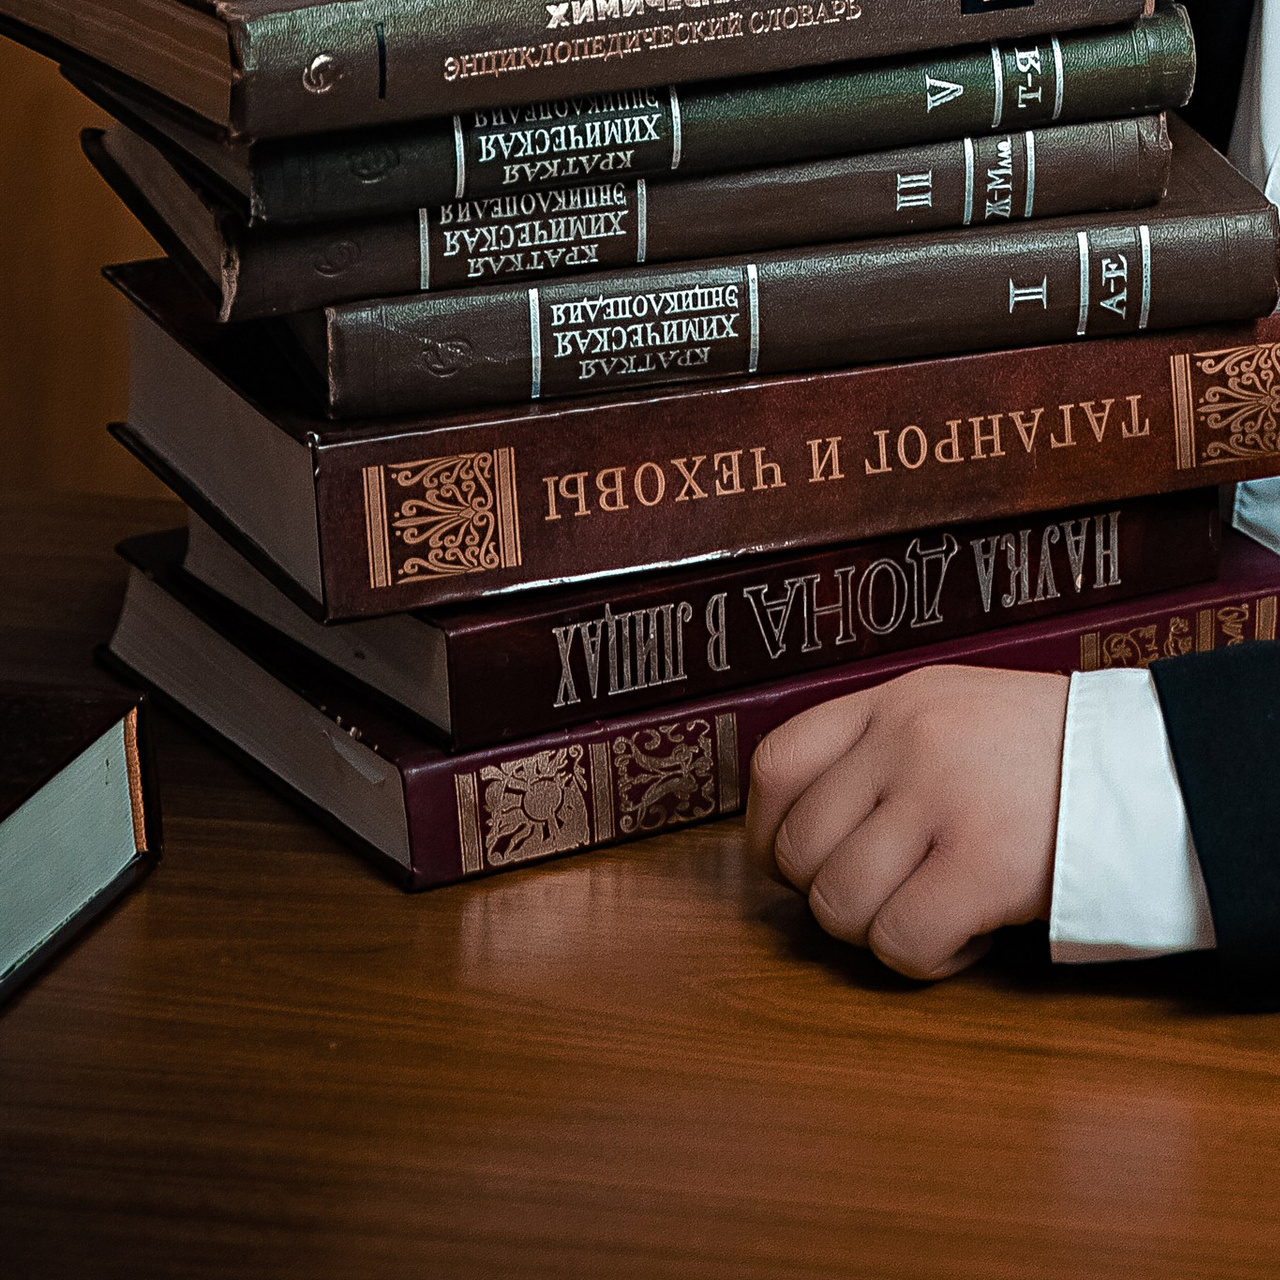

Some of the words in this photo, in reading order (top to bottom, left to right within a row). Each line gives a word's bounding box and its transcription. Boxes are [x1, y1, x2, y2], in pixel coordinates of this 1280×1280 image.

[444, 11, 744, 81] ЭНЦИКЛОПЕДИЧЕСКИЙ
[925, 73, 964, 114] V
[1015, 45, 1043, 109] Т-Я
[478, 113, 662, 163] ХИМИЧЕСКАЯ
[502, 149, 635, 185] КРАТКАЯ
[896, 169, 933, 212] II
[443, 209, 629, 257] ХИМИЧЕСКАЯ
[467, 243, 599, 278] КРАТКАЯ
[550, 284, 739, 327] ЭНЦИКЛОПЕДИЯ
[1009, 274, 1047, 314] I
[1099, 253, 1129, 321] А-Е
[553, 312, 740, 359] ХИМИЧЕСКАЯ
[578, 346, 711, 380] КРАТКАЯ
[865, 394, 1151, 475] ТАГАНРОГ
[543, 445, 787, 521] ЧЕХОВЫ
[806, 436, 846, 484] И
[969, 510, 1123, 614] НАУКА
[743, 533, 959, 659] ДОНА
[551, 601, 693, 708] ЛИЦАХ
[705, 591, 732, 672] В
